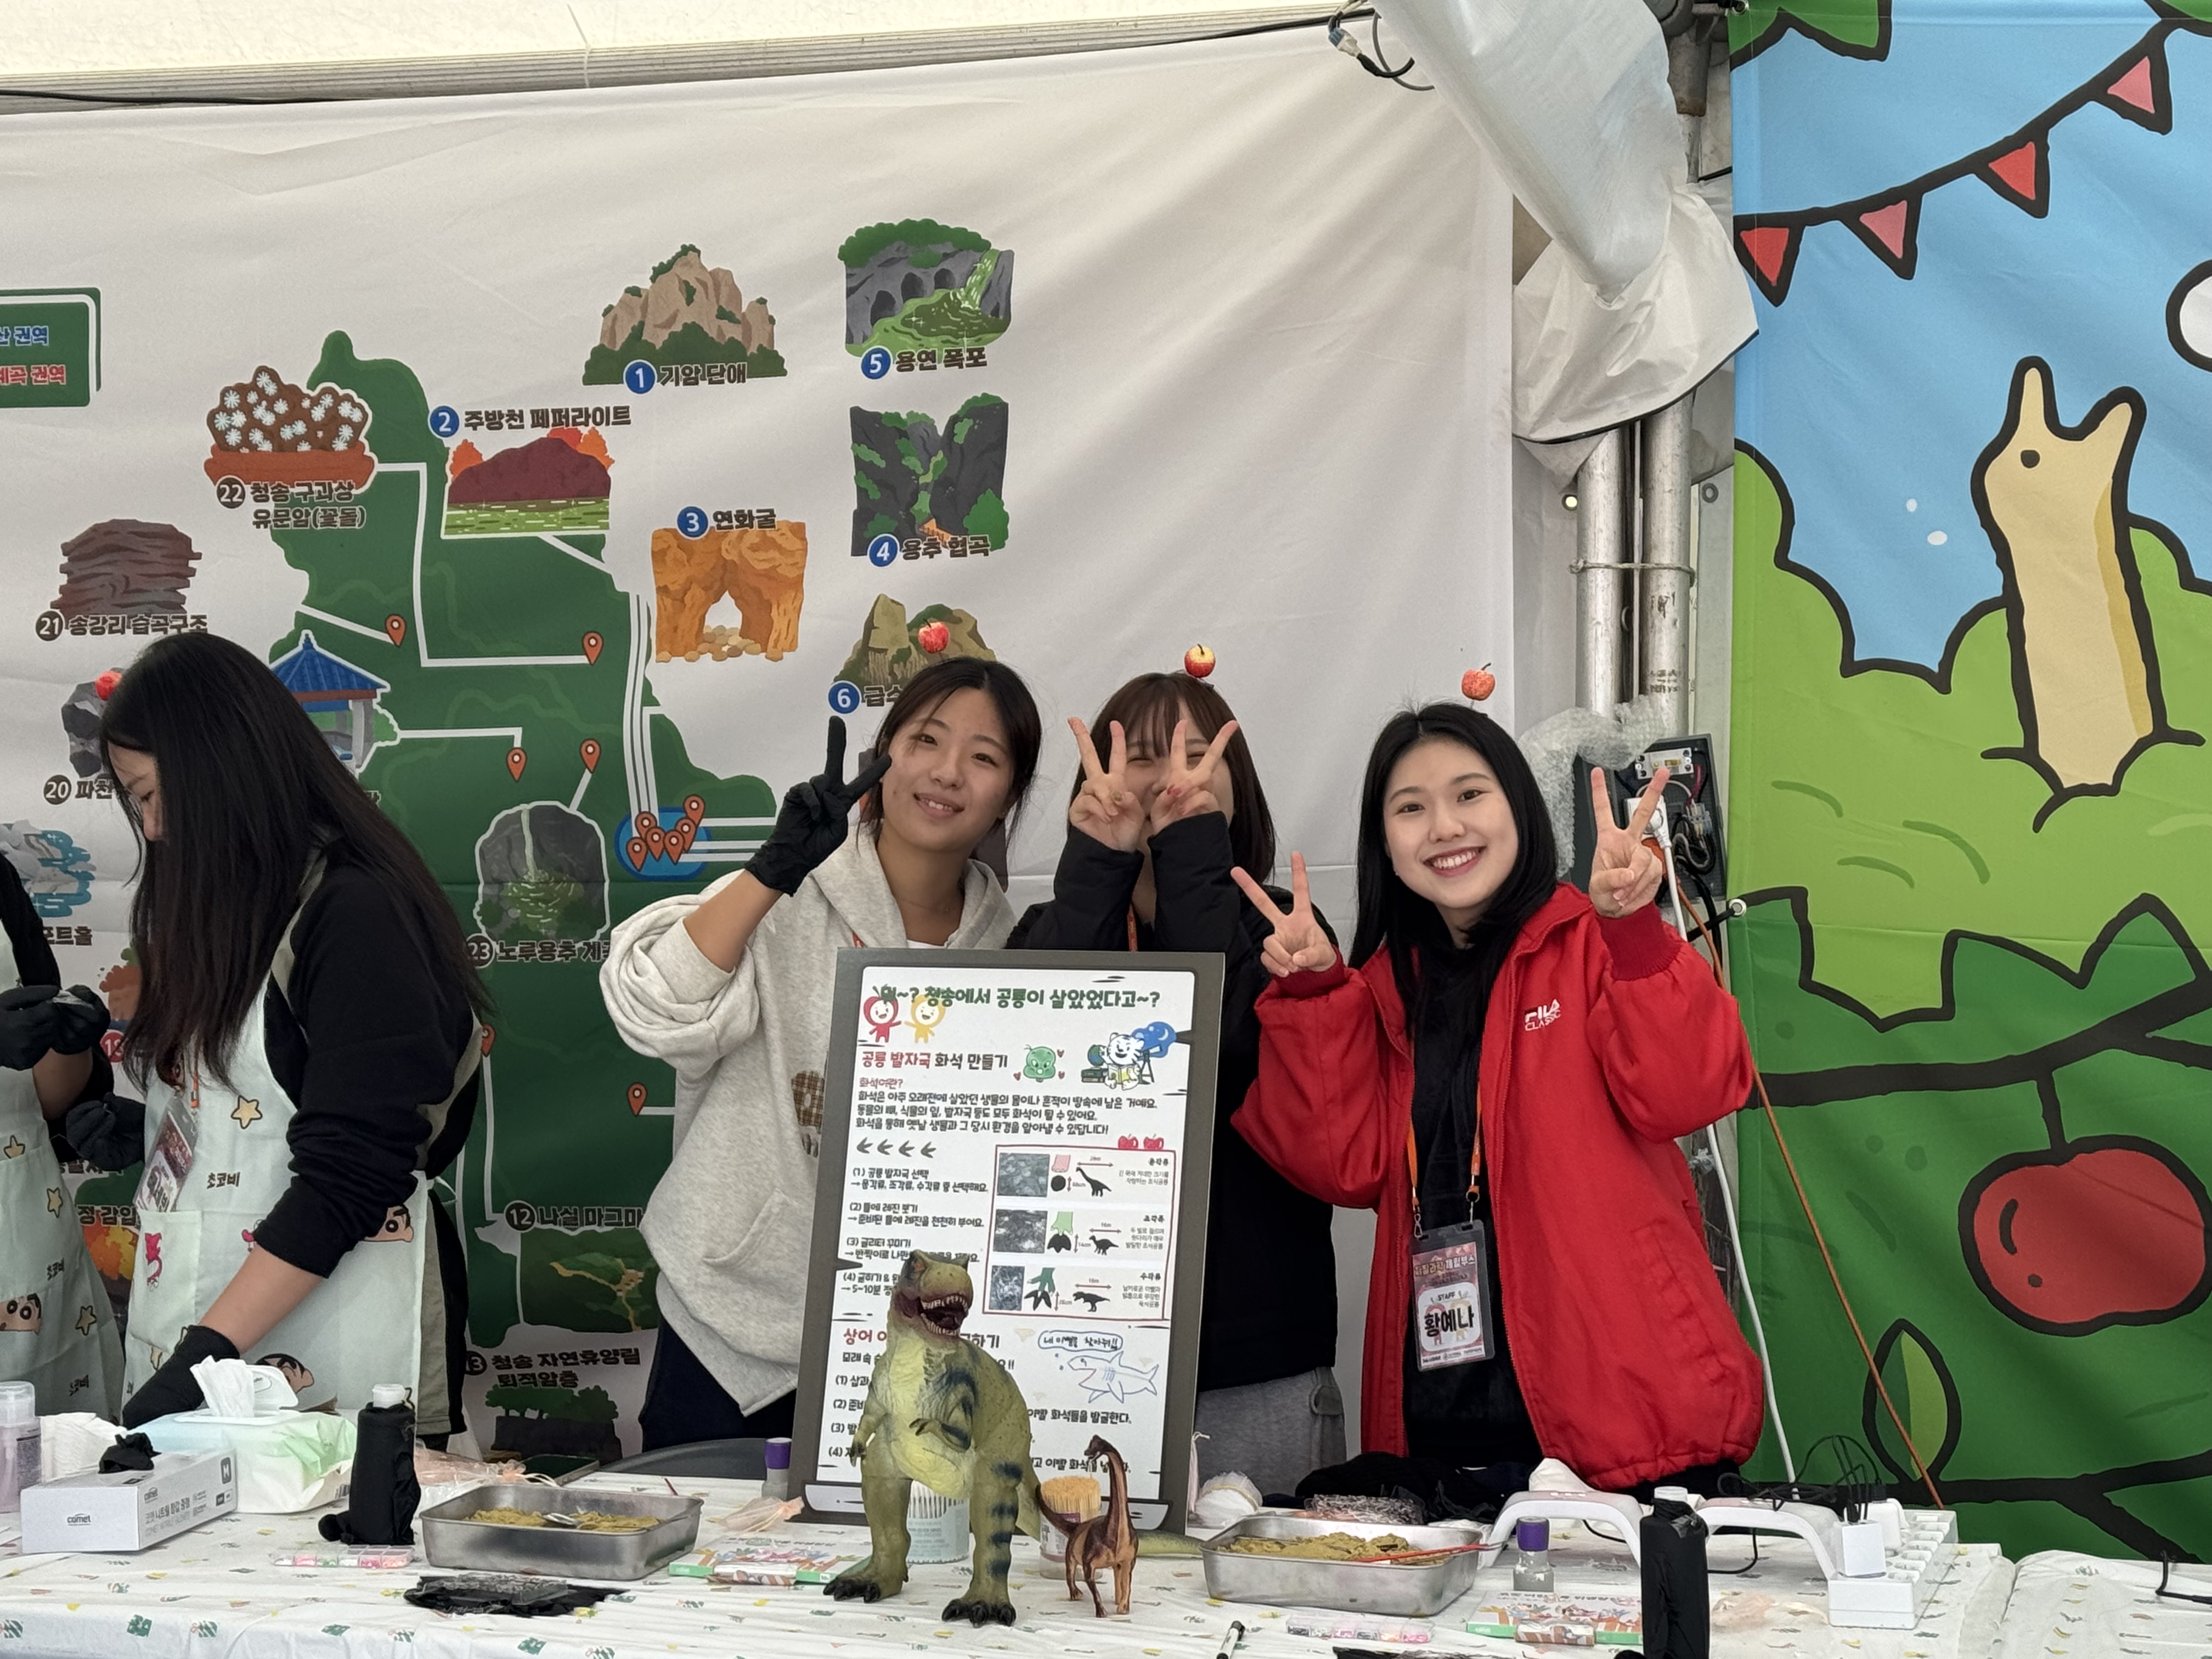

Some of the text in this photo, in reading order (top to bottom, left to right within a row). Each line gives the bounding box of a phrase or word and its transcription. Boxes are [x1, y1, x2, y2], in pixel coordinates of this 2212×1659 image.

[14, 326, 48, 346] 권역
[896, 350, 937, 372] 용연
[943, 347, 988, 369] 폭포
[31, 365, 65, 385] 권역
[659, 365, 701, 386] 기암
[706, 363, 747, 384] 단애
[464, 409, 524, 430] 주방천
[531, 405, 631, 428] 페퍼라이트
[251, 482, 290, 502] 청송
[295, 481, 355, 502] 구과상
[252, 507, 366, 529] 유문암(꽃돌)
[713, 509, 776, 530] 연화굴
[902, 537, 941, 560] 용추
[949, 535, 989, 557] 협곡
[69, 614, 126, 635] 송강리
[132, 614, 208, 635] 습곡구조
[497, 940, 577, 961] 노루용추
[925, 986, 991, 1007] 청송에서
[997, 988, 1044, 1008] 공룡이
[1049, 989, 1160, 1009] 살았었다고~?
[862, 1051, 1008, 1070] 공룡 발자국 화석 만들기
[859, 1077, 904, 1090] 화석이란?
[858, 1091, 885, 1103] 화석은
[888, 1092, 906, 1102] 아주
[909, 1092, 947, 1103] 오래전에
[949, 1093, 978, 1105] 살았던
[980, 1094, 1009, 1106] 생물의
[1012, 1094, 1040, 1107] 몸이나
[1042, 1096, 1070, 1107] 흔적이
[1073, 1097, 1102, 1108] 땅속에
[1104, 1097, 1122, 1109] 남은
[857, 1104, 883, 1115] 동물의
[900, 1105, 927, 1117] 식물의
[930, 1106, 941, 1118] 잎,
[945, 1107, 971, 1118] 발자국
[993, 1108, 1009, 1119] 모두
[1013, 1109, 1041, 1120] 화석이
[1056, 1110, 1065, 1121] 수
[856, 1118, 882, 1129] 화석을
[885, 1119, 904, 1130] 통해
[906, 1119, 927, 1131] 옛날
[929, 1120, 957, 1132] 생물과
[960, 1120, 968, 1131] 그
[971, 1121, 990, 1133] 당시
[992, 1121, 1019, 1133] 환경을
[1022, 1123, 1053, 1135] 알아낼
[1056, 1124, 1064, 1135] 수
[868, 1167, 883, 1178] 공룡
[911, 1169, 929, 1180] 선택
[539, 1206, 579, 1228] 나실
[850, 1203, 861, 1212] (2)
[882, 1203, 900, 1214] 레진
[859, 1214, 883, 1225] 준비된
[905, 1215, 929, 1227] 레진을
[931, 1216, 956, 1227] 천천히
[847, 1237, 911, 1249] (3) 글리터 꾸미기
[891, 1250, 912, 1261] 나만
[843, 1273, 855, 1282] (4)
[844, 1328, 872, 1345] 상어
[492, 1352, 533, 1370] 청송
[537, 1348, 640, 1367] 자연휴양림
[843, 1352, 861, 1362] 모래
[498, 1370, 579, 1388] 퇴적암층
[836, 1375, 848, 1385] (1)
[833, 1399, 847, 1409] (2)
[1051, 1409, 1087, 1423] 화석들을
[1091, 1411, 1132, 1425] 발굴한다.
[831, 1423, 844, 1433] (3)
[828, 1447, 842, 1457] (4)
[1046, 1459, 1067, 1471] 이빨
[67, 1514, 92, 1523] comet
